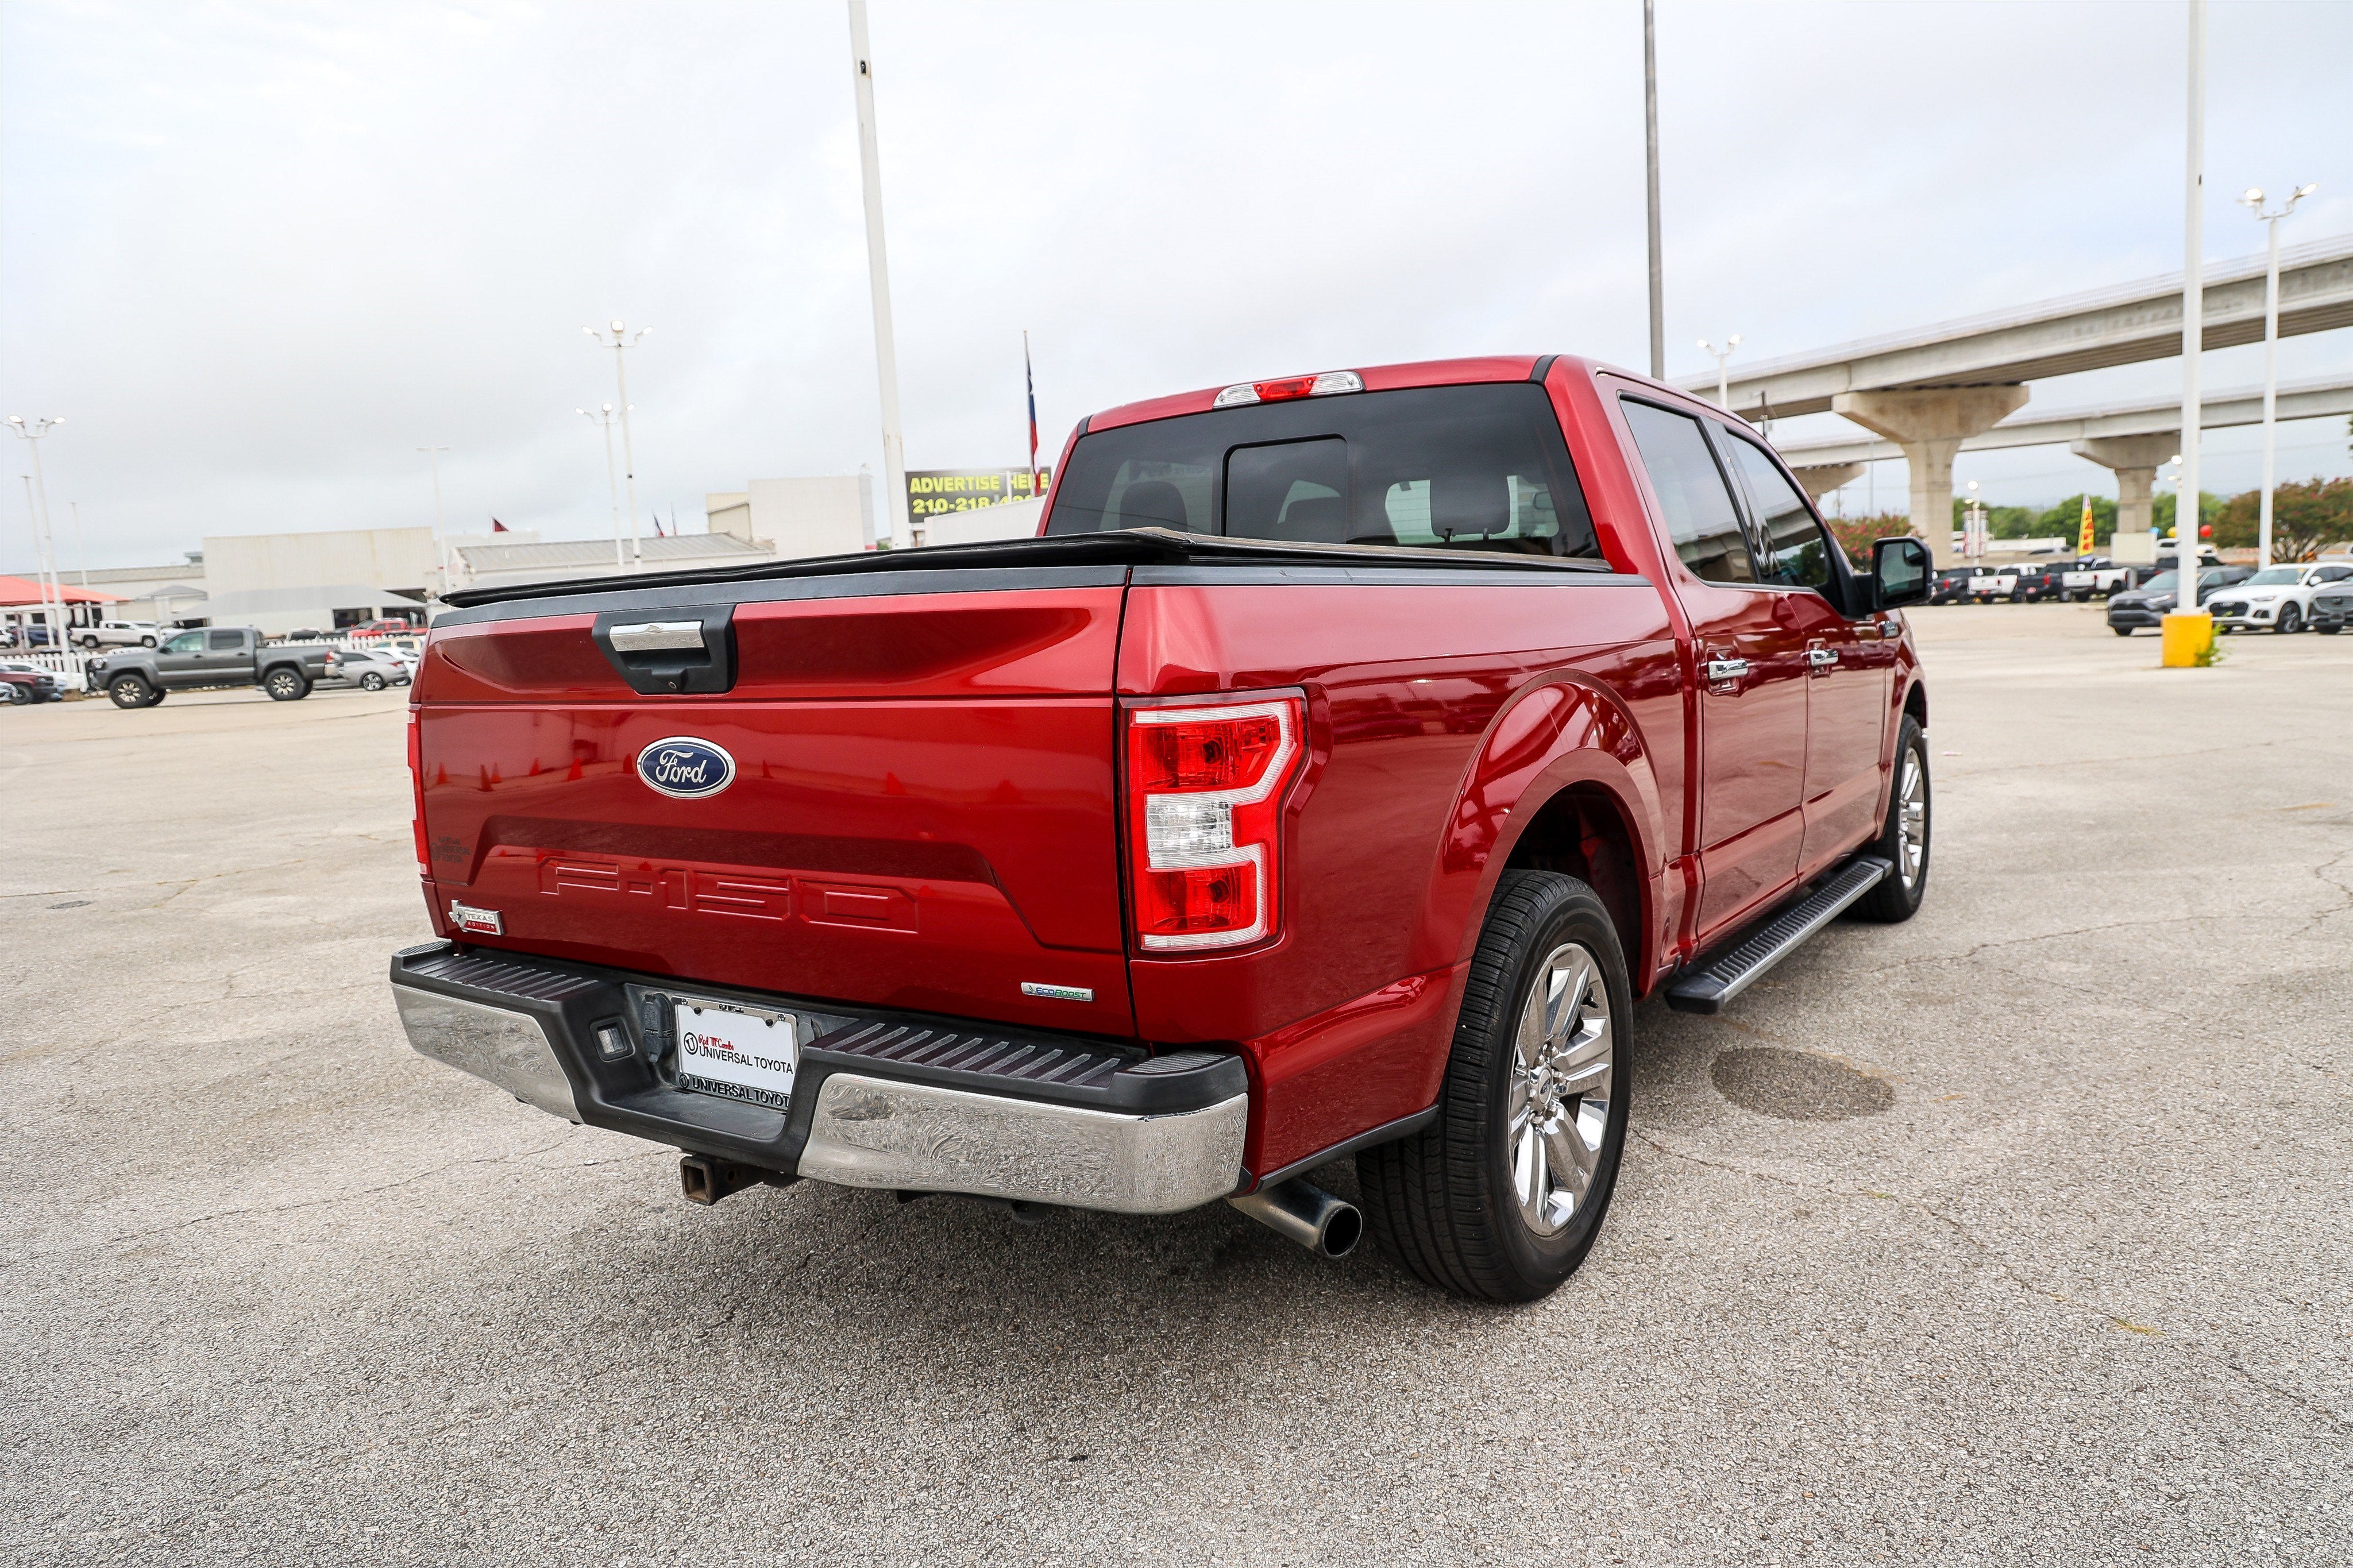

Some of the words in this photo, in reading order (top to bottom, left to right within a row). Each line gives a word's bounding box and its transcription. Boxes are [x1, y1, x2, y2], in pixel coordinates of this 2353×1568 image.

[909, 475, 1001, 494] ADVERTISE
[655, 750, 707, 783] Ford
[539, 856, 918, 934] F-150
[465, 912, 493, 922] TEXAS
[699, 1034, 709, 1046] Red
[699, 1045, 753, 1067] UNIVERSAL
[754, 1056, 793, 1075] TOYOTA
[692, 1076, 753, 1100] UNIVERSAL
[754, 1089, 790, 1108] TOYOT
